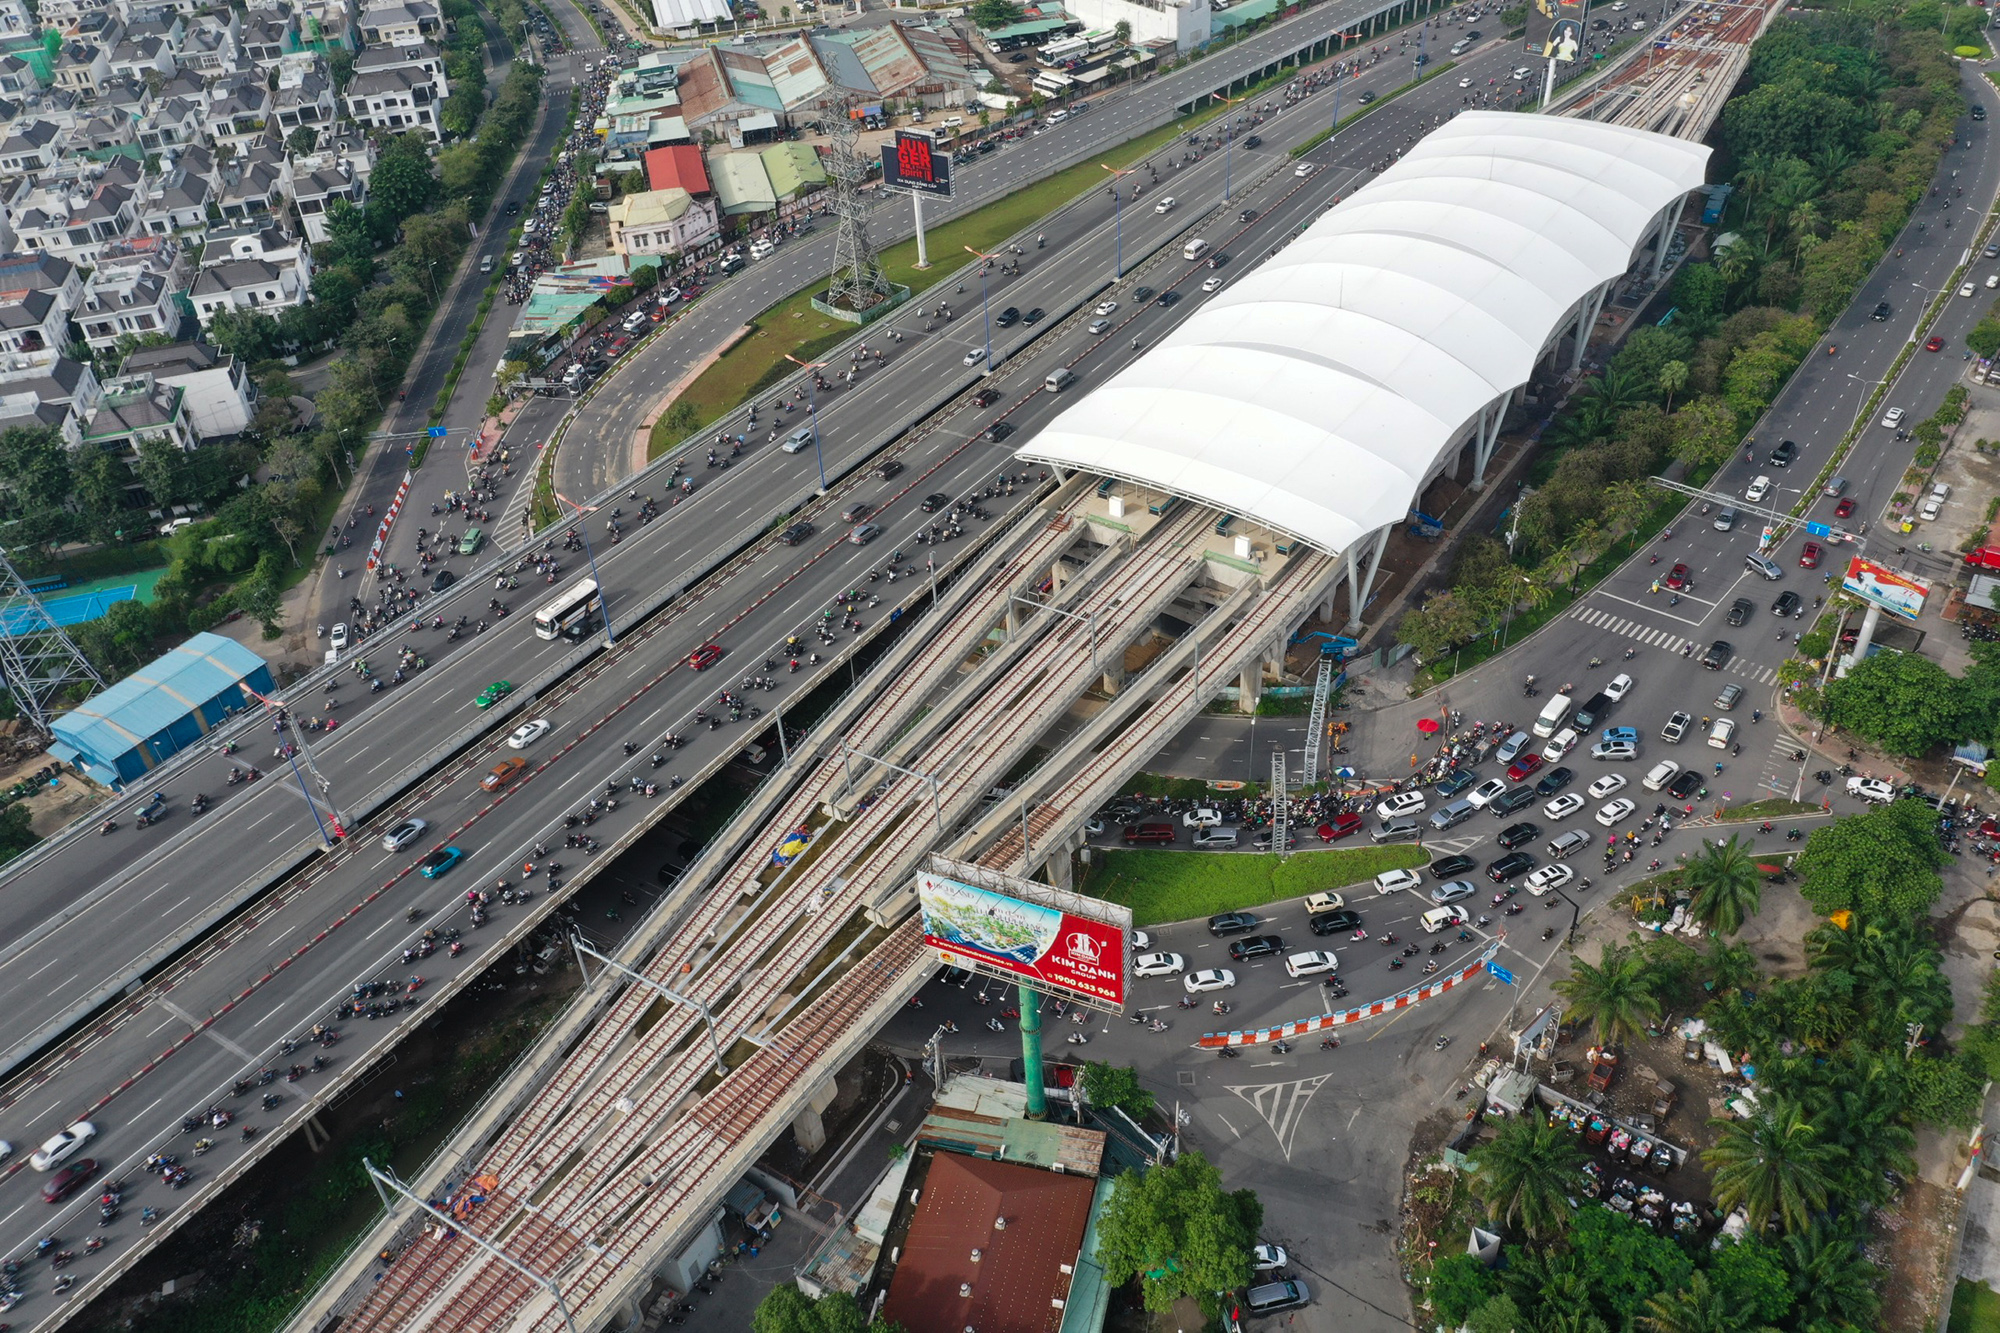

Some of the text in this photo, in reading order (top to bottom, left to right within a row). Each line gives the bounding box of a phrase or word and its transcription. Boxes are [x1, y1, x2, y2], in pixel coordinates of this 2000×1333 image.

[898, 138, 928, 154] JUN
[898, 149, 931, 168] GER
[1051, 954, 1116, 981] KIM OANH
[1070, 969, 1097, 980] GROUP
[1054, 973, 1116, 998] 1900 633 968
